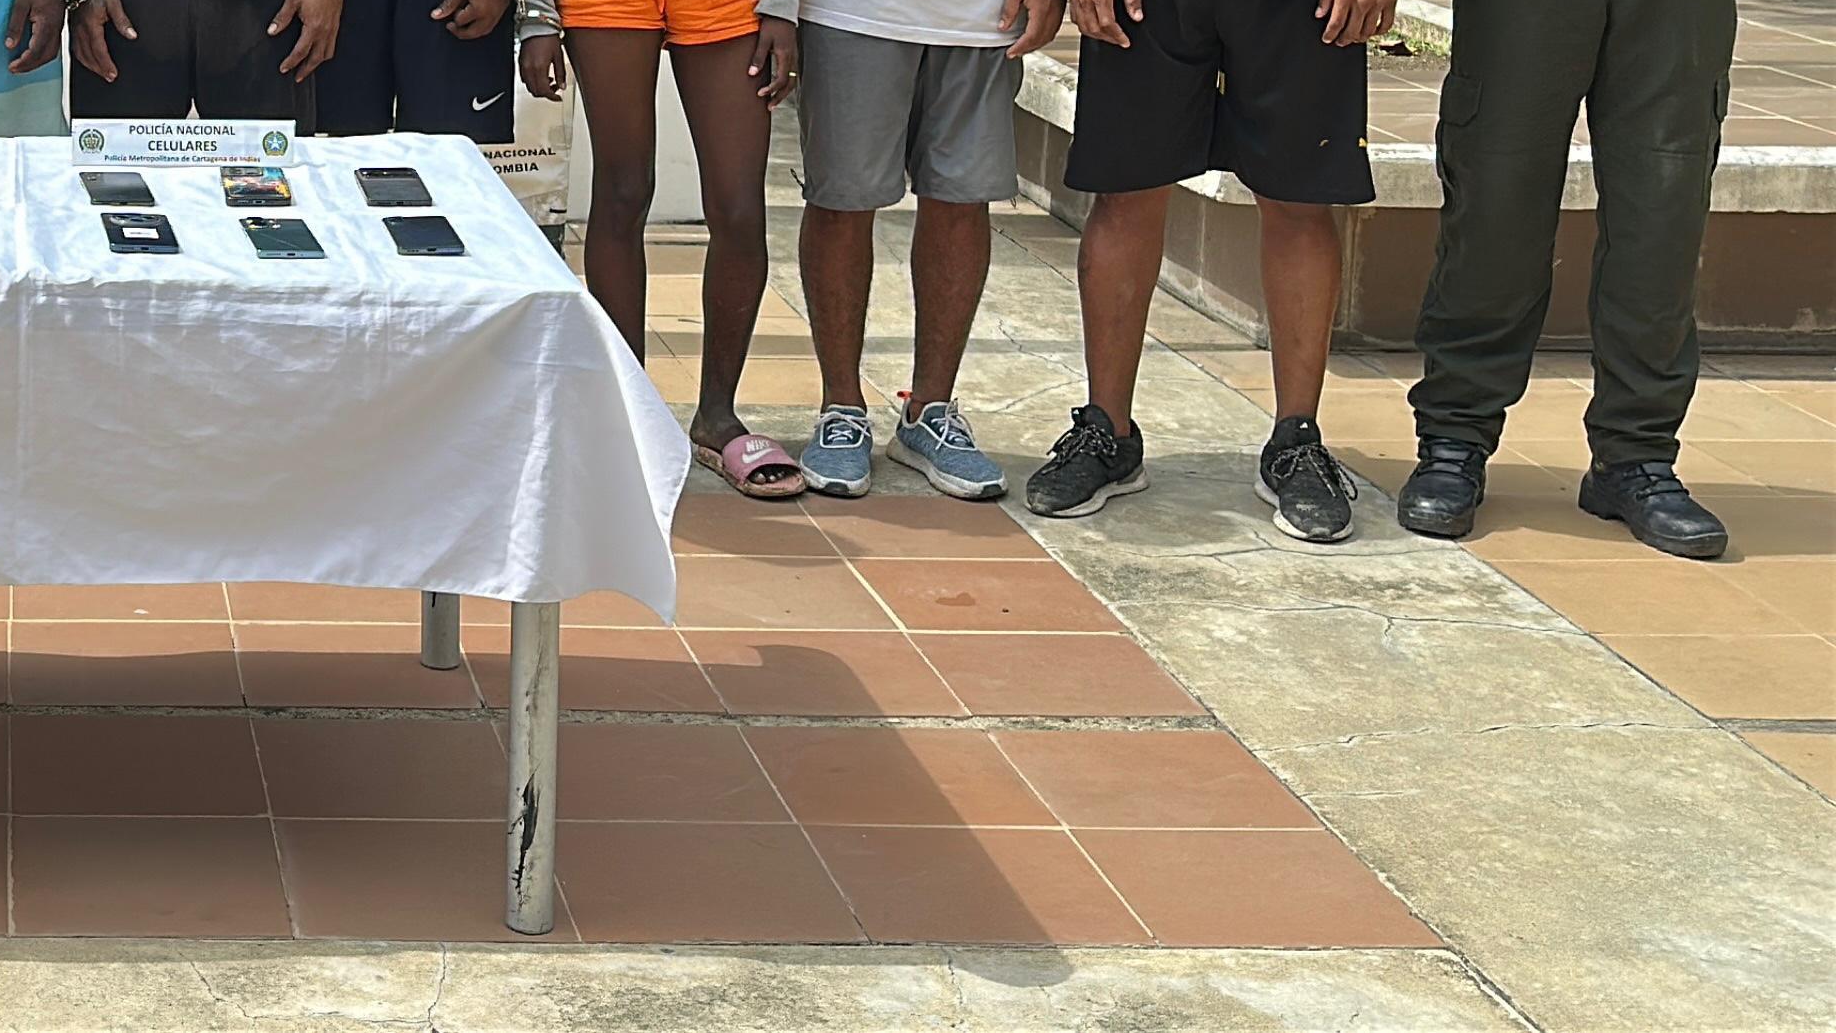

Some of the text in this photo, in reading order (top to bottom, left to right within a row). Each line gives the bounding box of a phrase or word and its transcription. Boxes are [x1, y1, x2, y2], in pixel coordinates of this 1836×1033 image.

[129, 123, 236, 136] POLICÍA NACIONAL
[147, 140, 218, 152] CELULARES
[483, 148, 556, 159] NACIONAL
[493, 162, 539, 175] OMBIA
